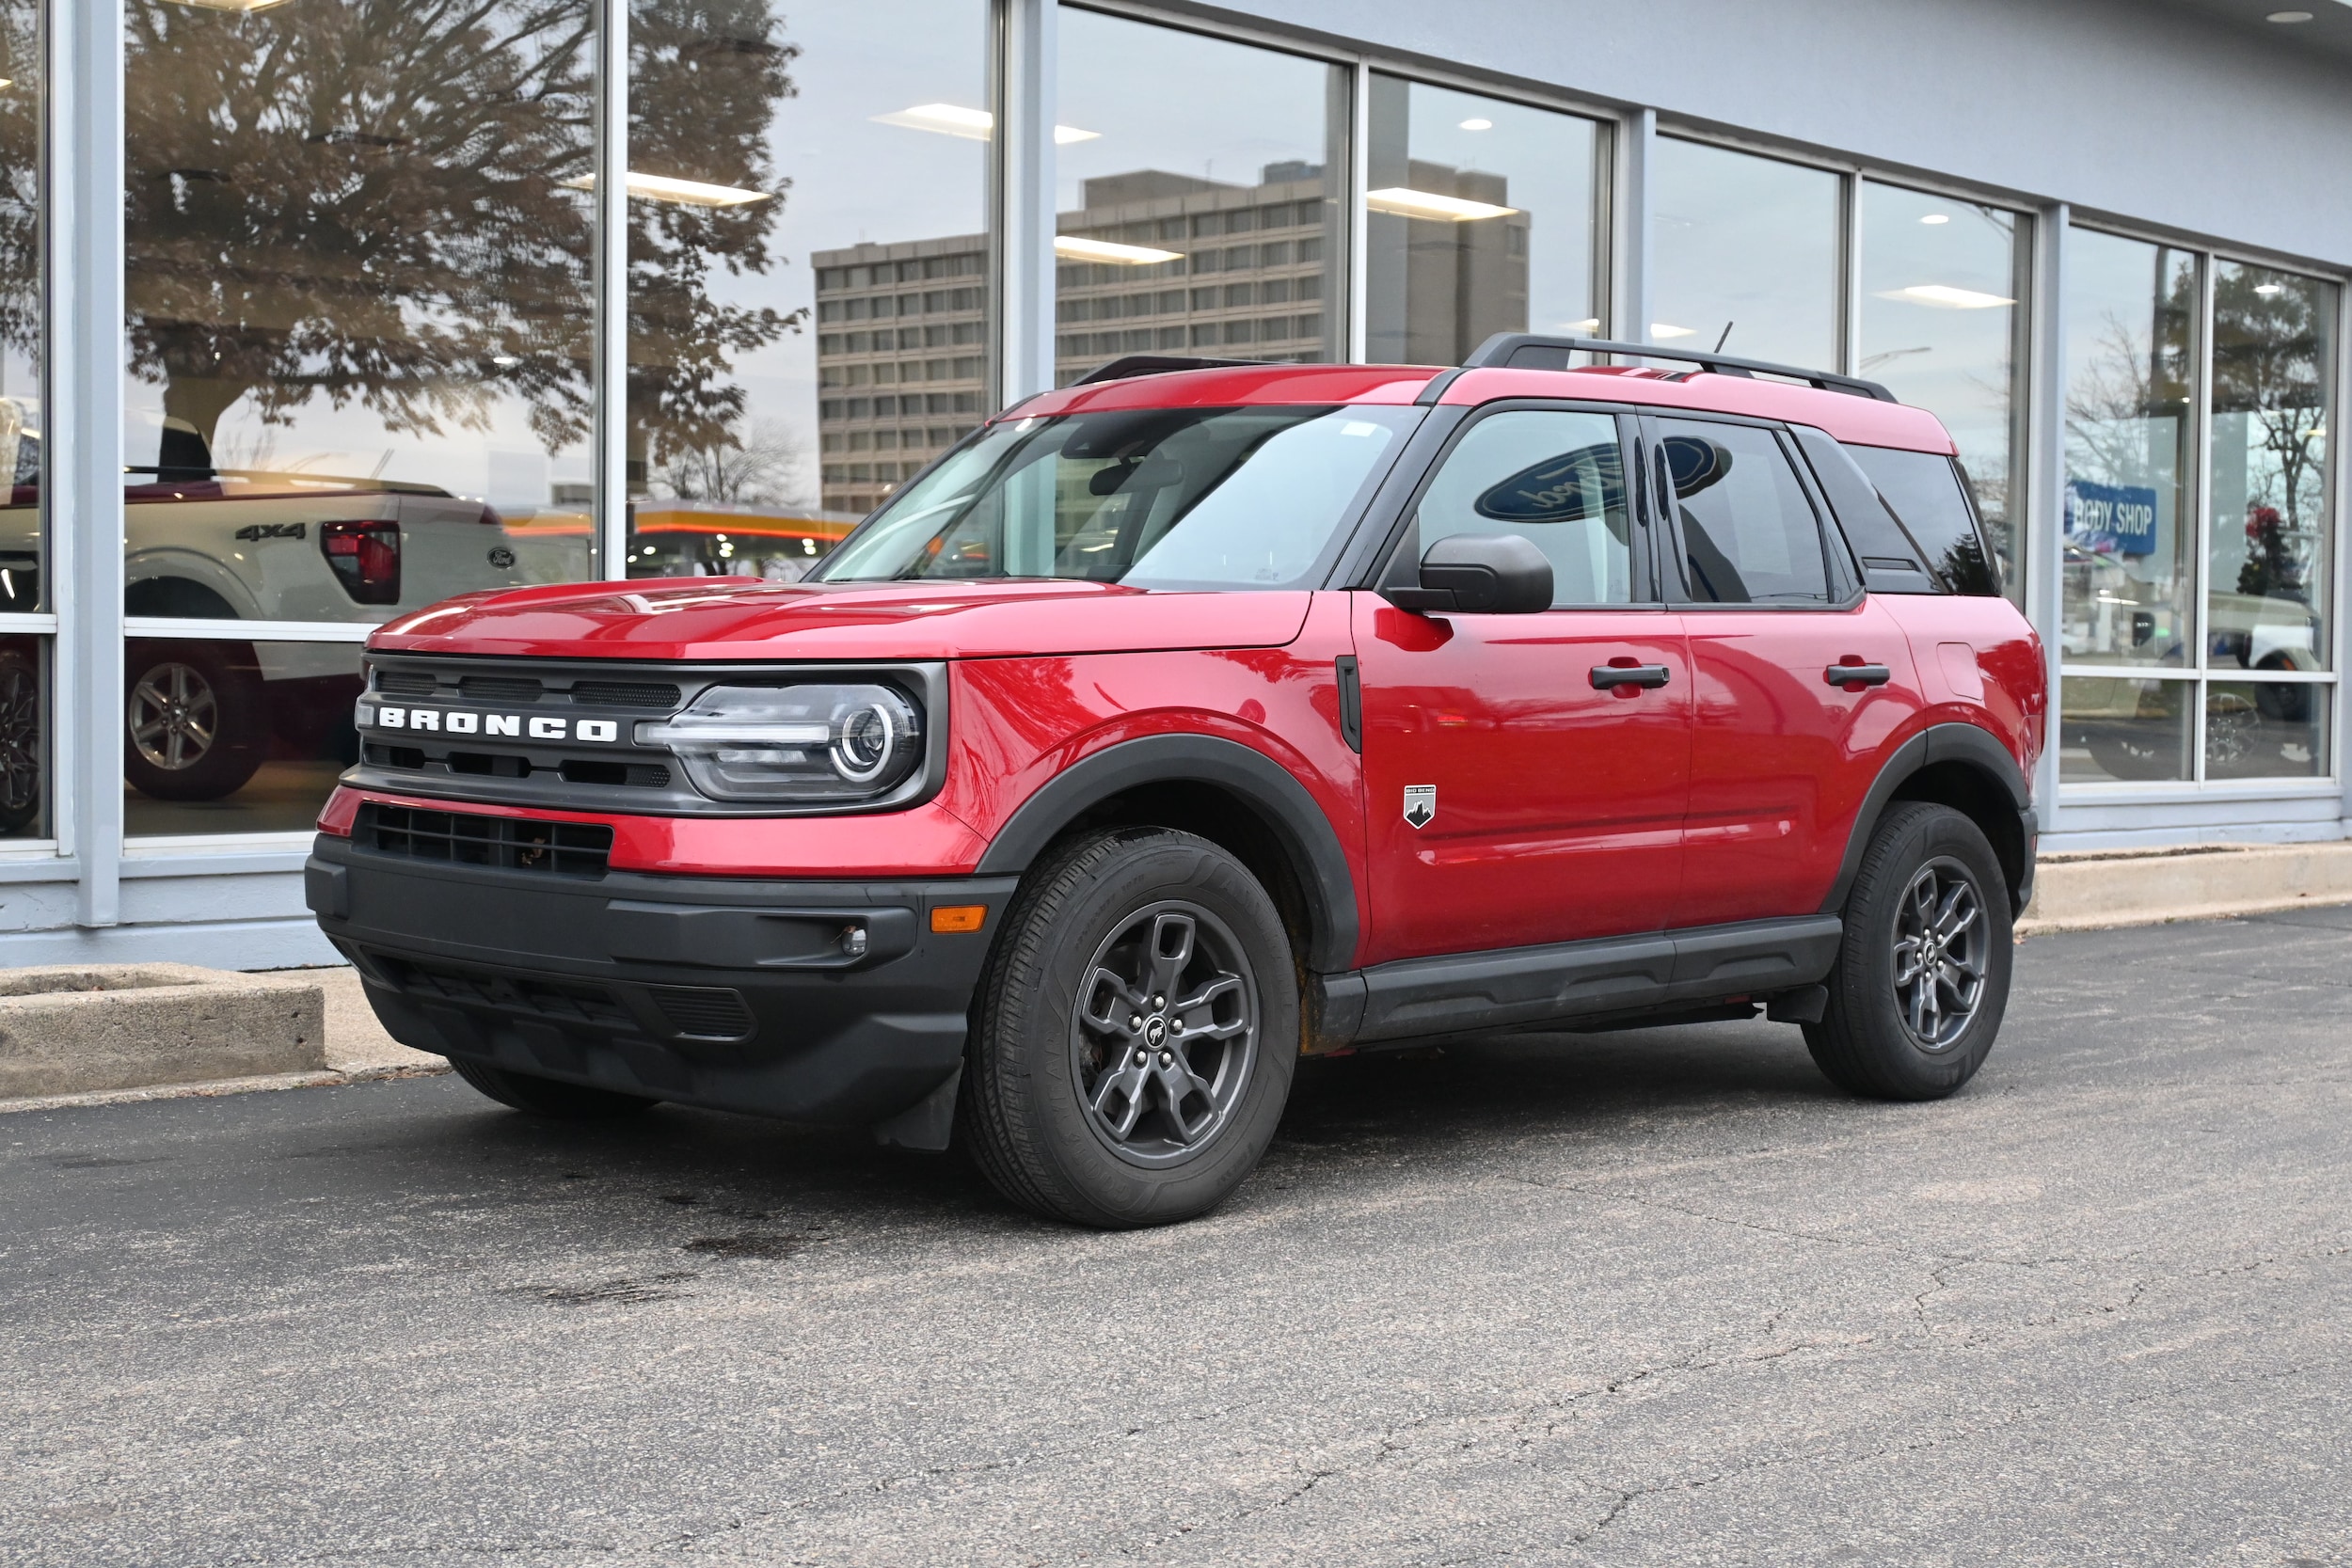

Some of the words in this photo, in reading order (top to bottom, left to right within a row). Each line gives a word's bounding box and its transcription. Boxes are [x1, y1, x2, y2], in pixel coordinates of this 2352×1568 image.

[2074, 499, 2113, 531] BODY
[2116, 502, 2153, 535] SHOP
[378, 706, 618, 742] BRONCO
